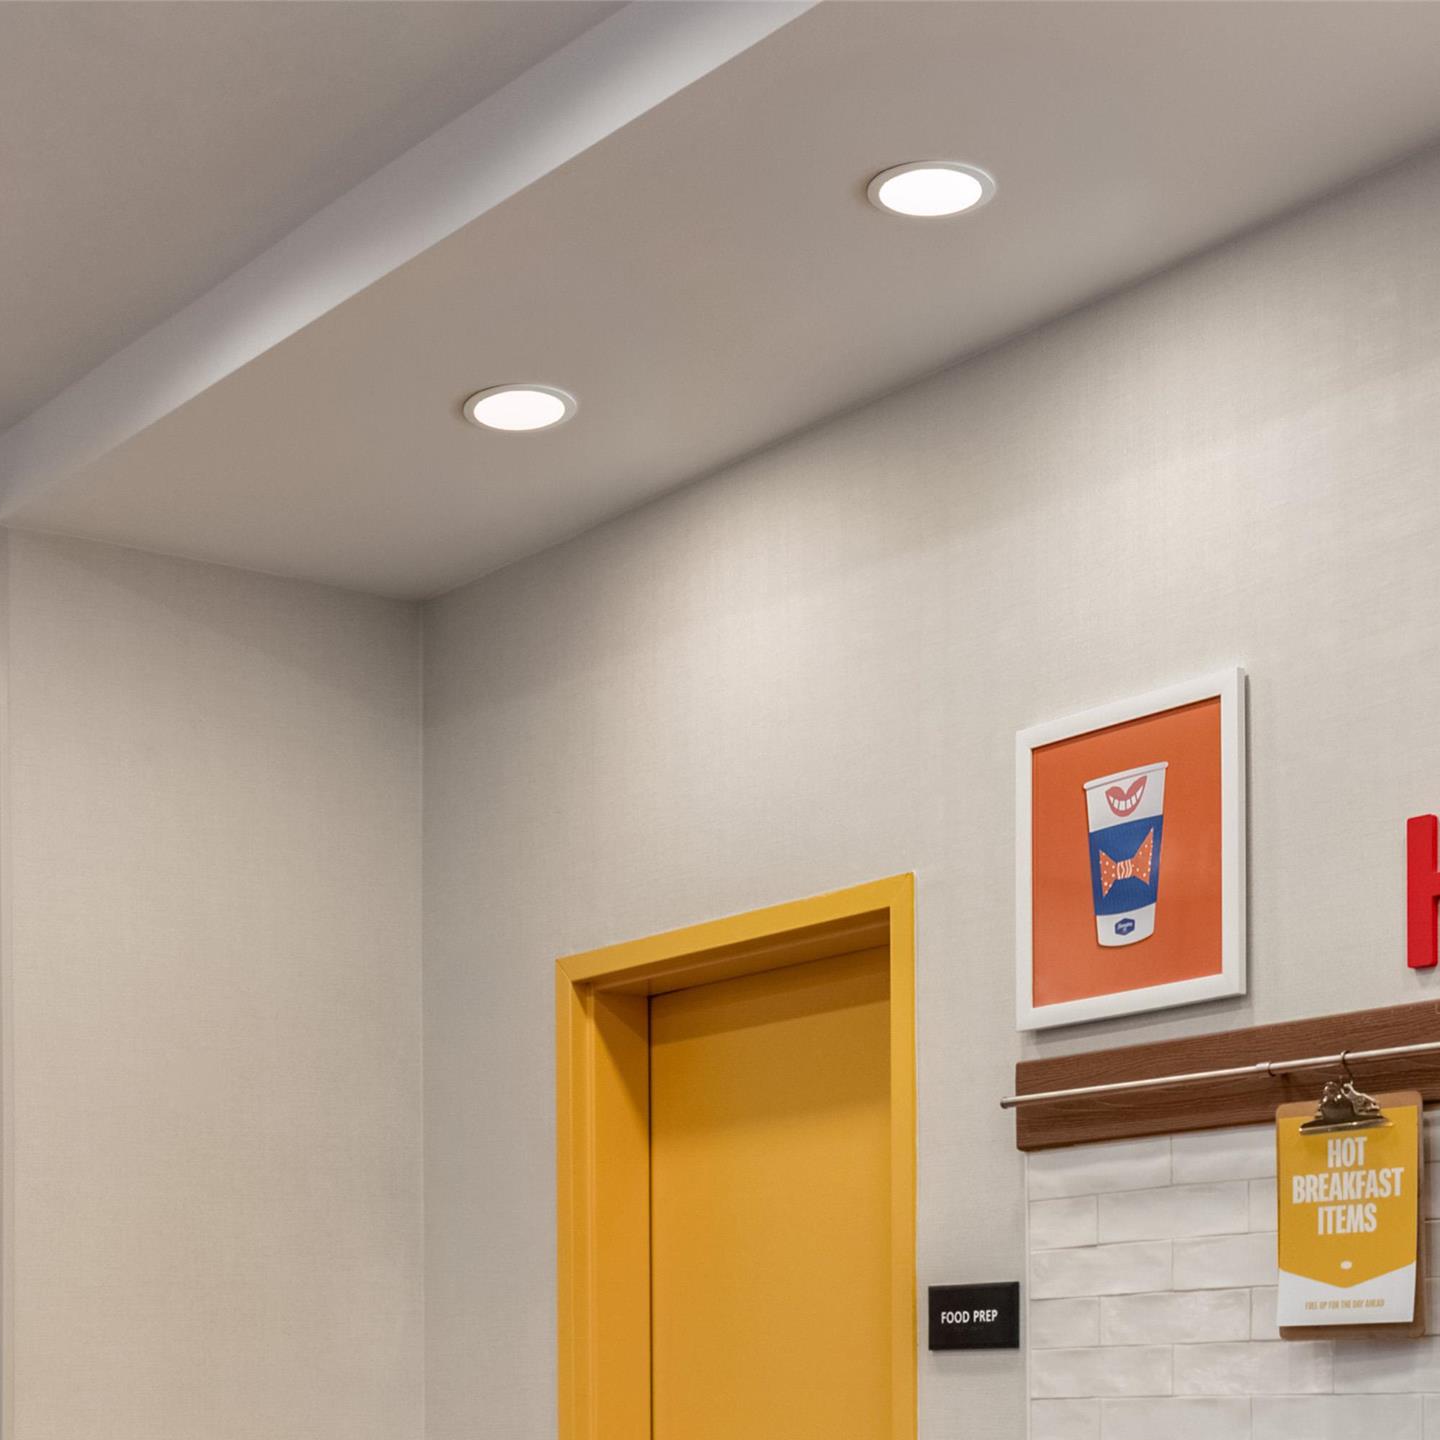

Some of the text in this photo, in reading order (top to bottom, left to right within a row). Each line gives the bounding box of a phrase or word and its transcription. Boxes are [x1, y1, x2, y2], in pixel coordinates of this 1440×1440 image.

[1327, 1137, 1368, 1169] HOT
[1292, 1167, 1405, 1205] BREAKFAST
[1317, 1202, 1378, 1236] ITEMS
[941, 1309, 998, 1324] FOOD PREP
